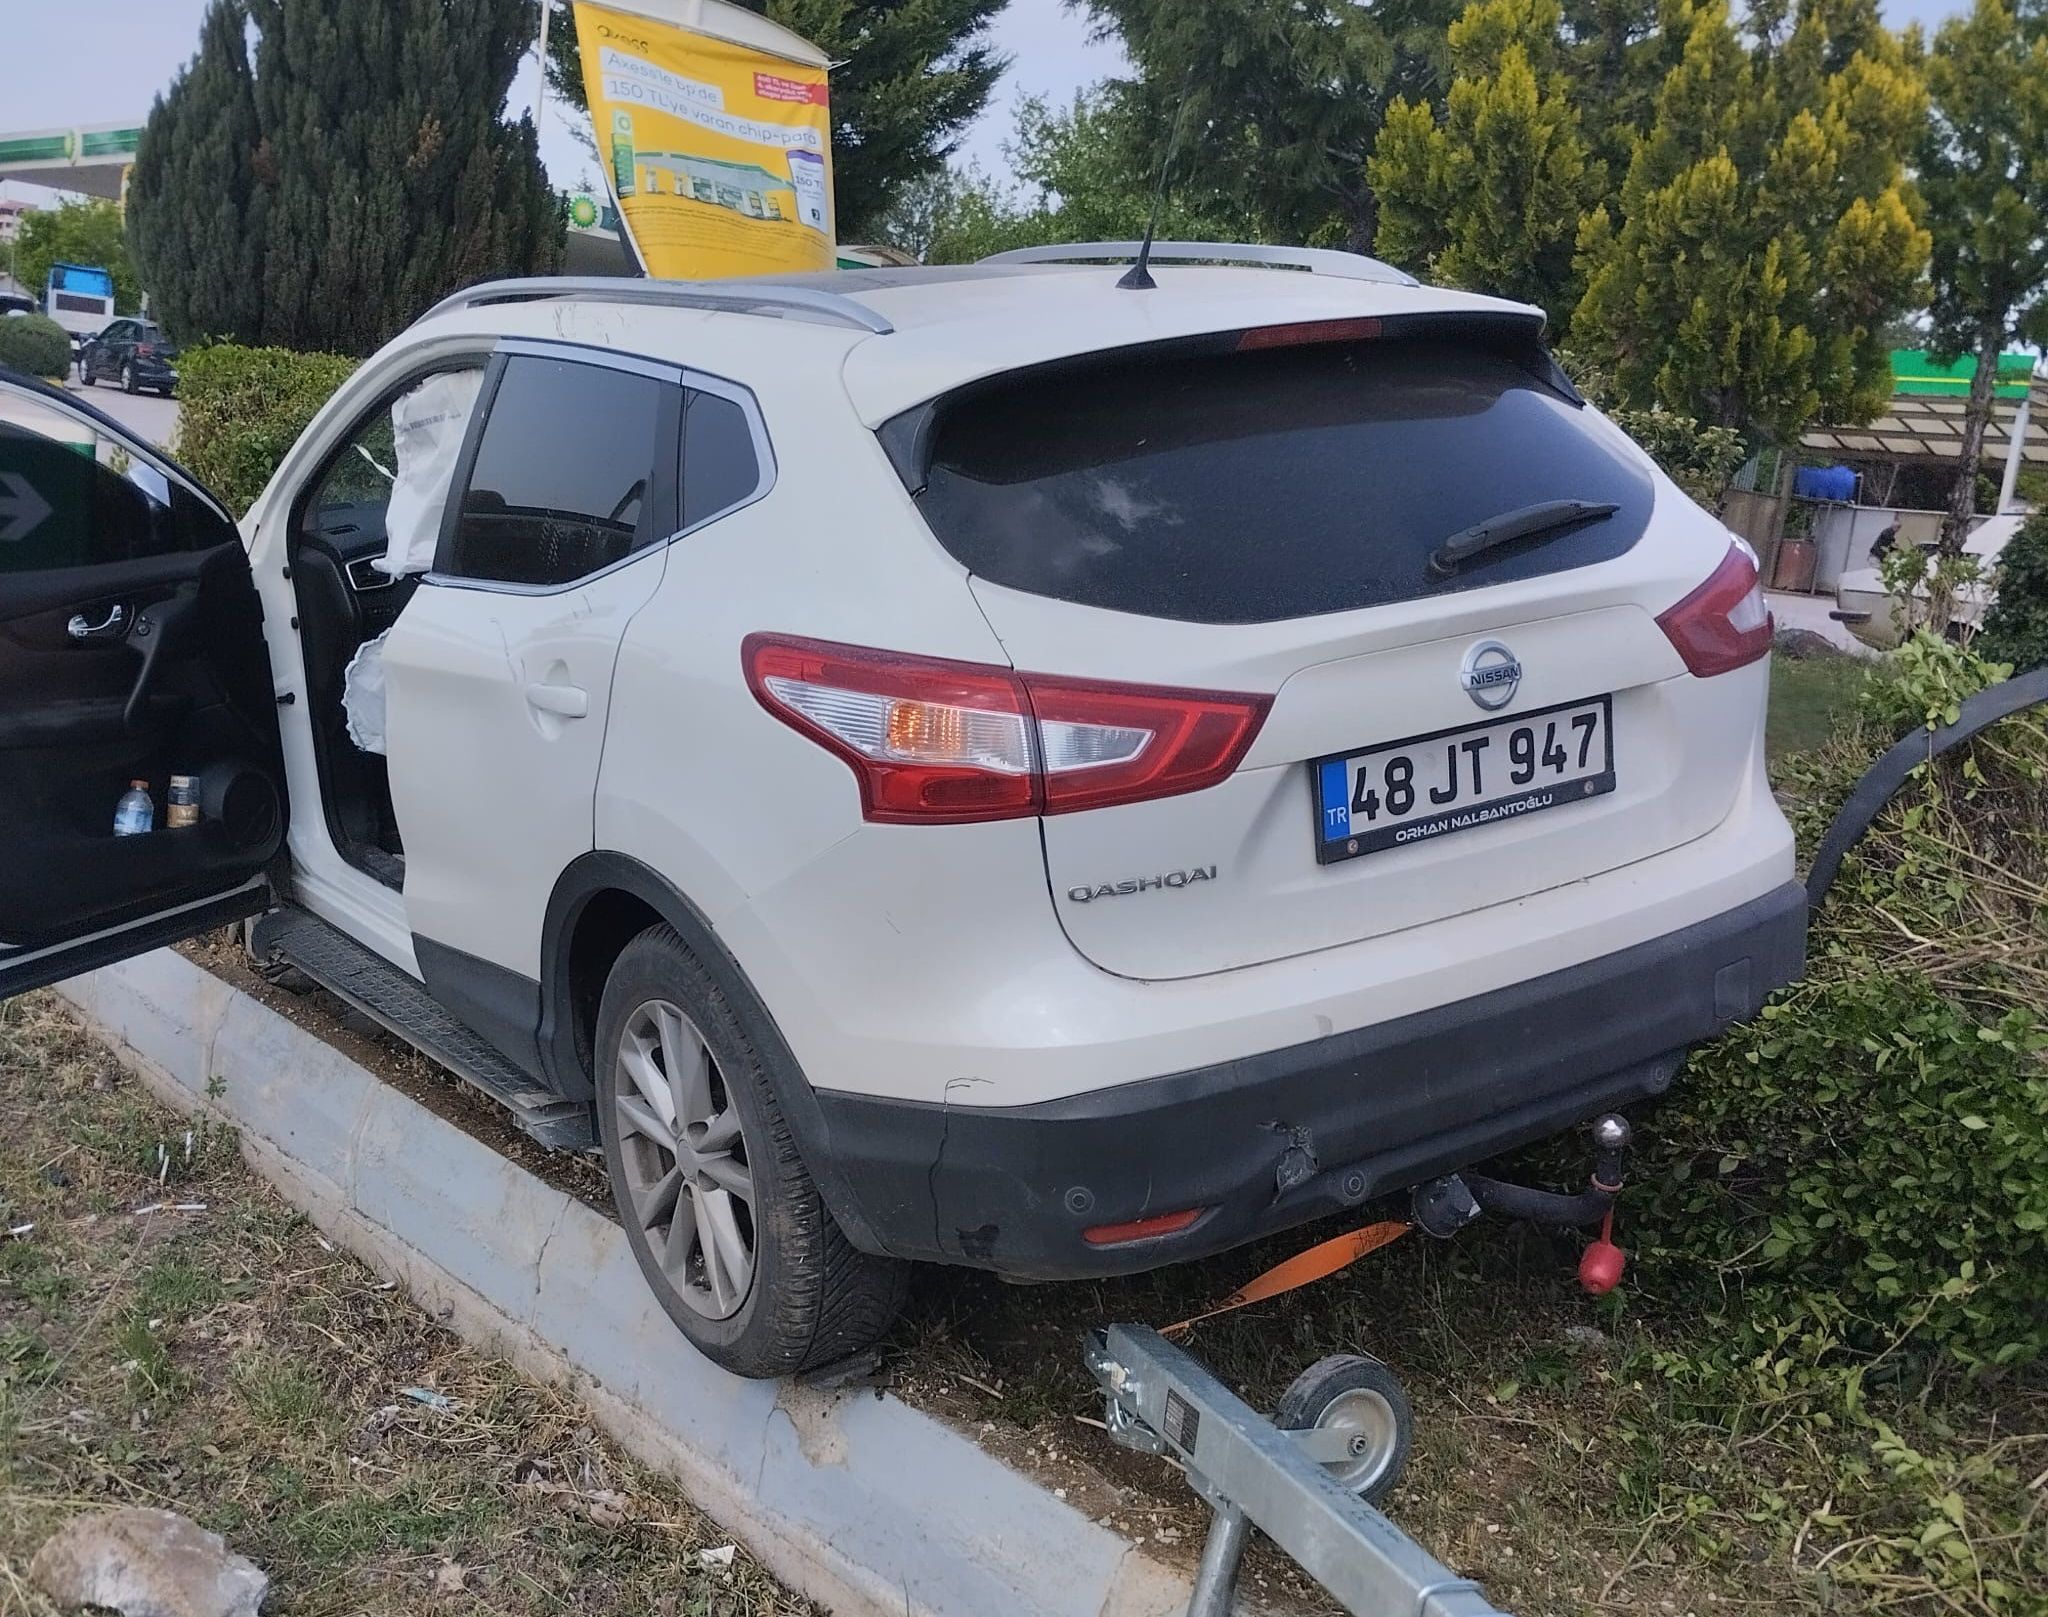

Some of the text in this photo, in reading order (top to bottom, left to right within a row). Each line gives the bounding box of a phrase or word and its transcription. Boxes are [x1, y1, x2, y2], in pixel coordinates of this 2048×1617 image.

[610, 81, 817, 145] 150 TL'ye varan chip-para
[1470, 666, 1519, 686] NISSAN
[1351, 712, 1598, 821] 48 JT 947
[1327, 807, 1348, 826] TR
[1395, 793, 1553, 842] ORHAN NALBANTOĞLU
[1067, 865, 1217, 903] QASHQAI
